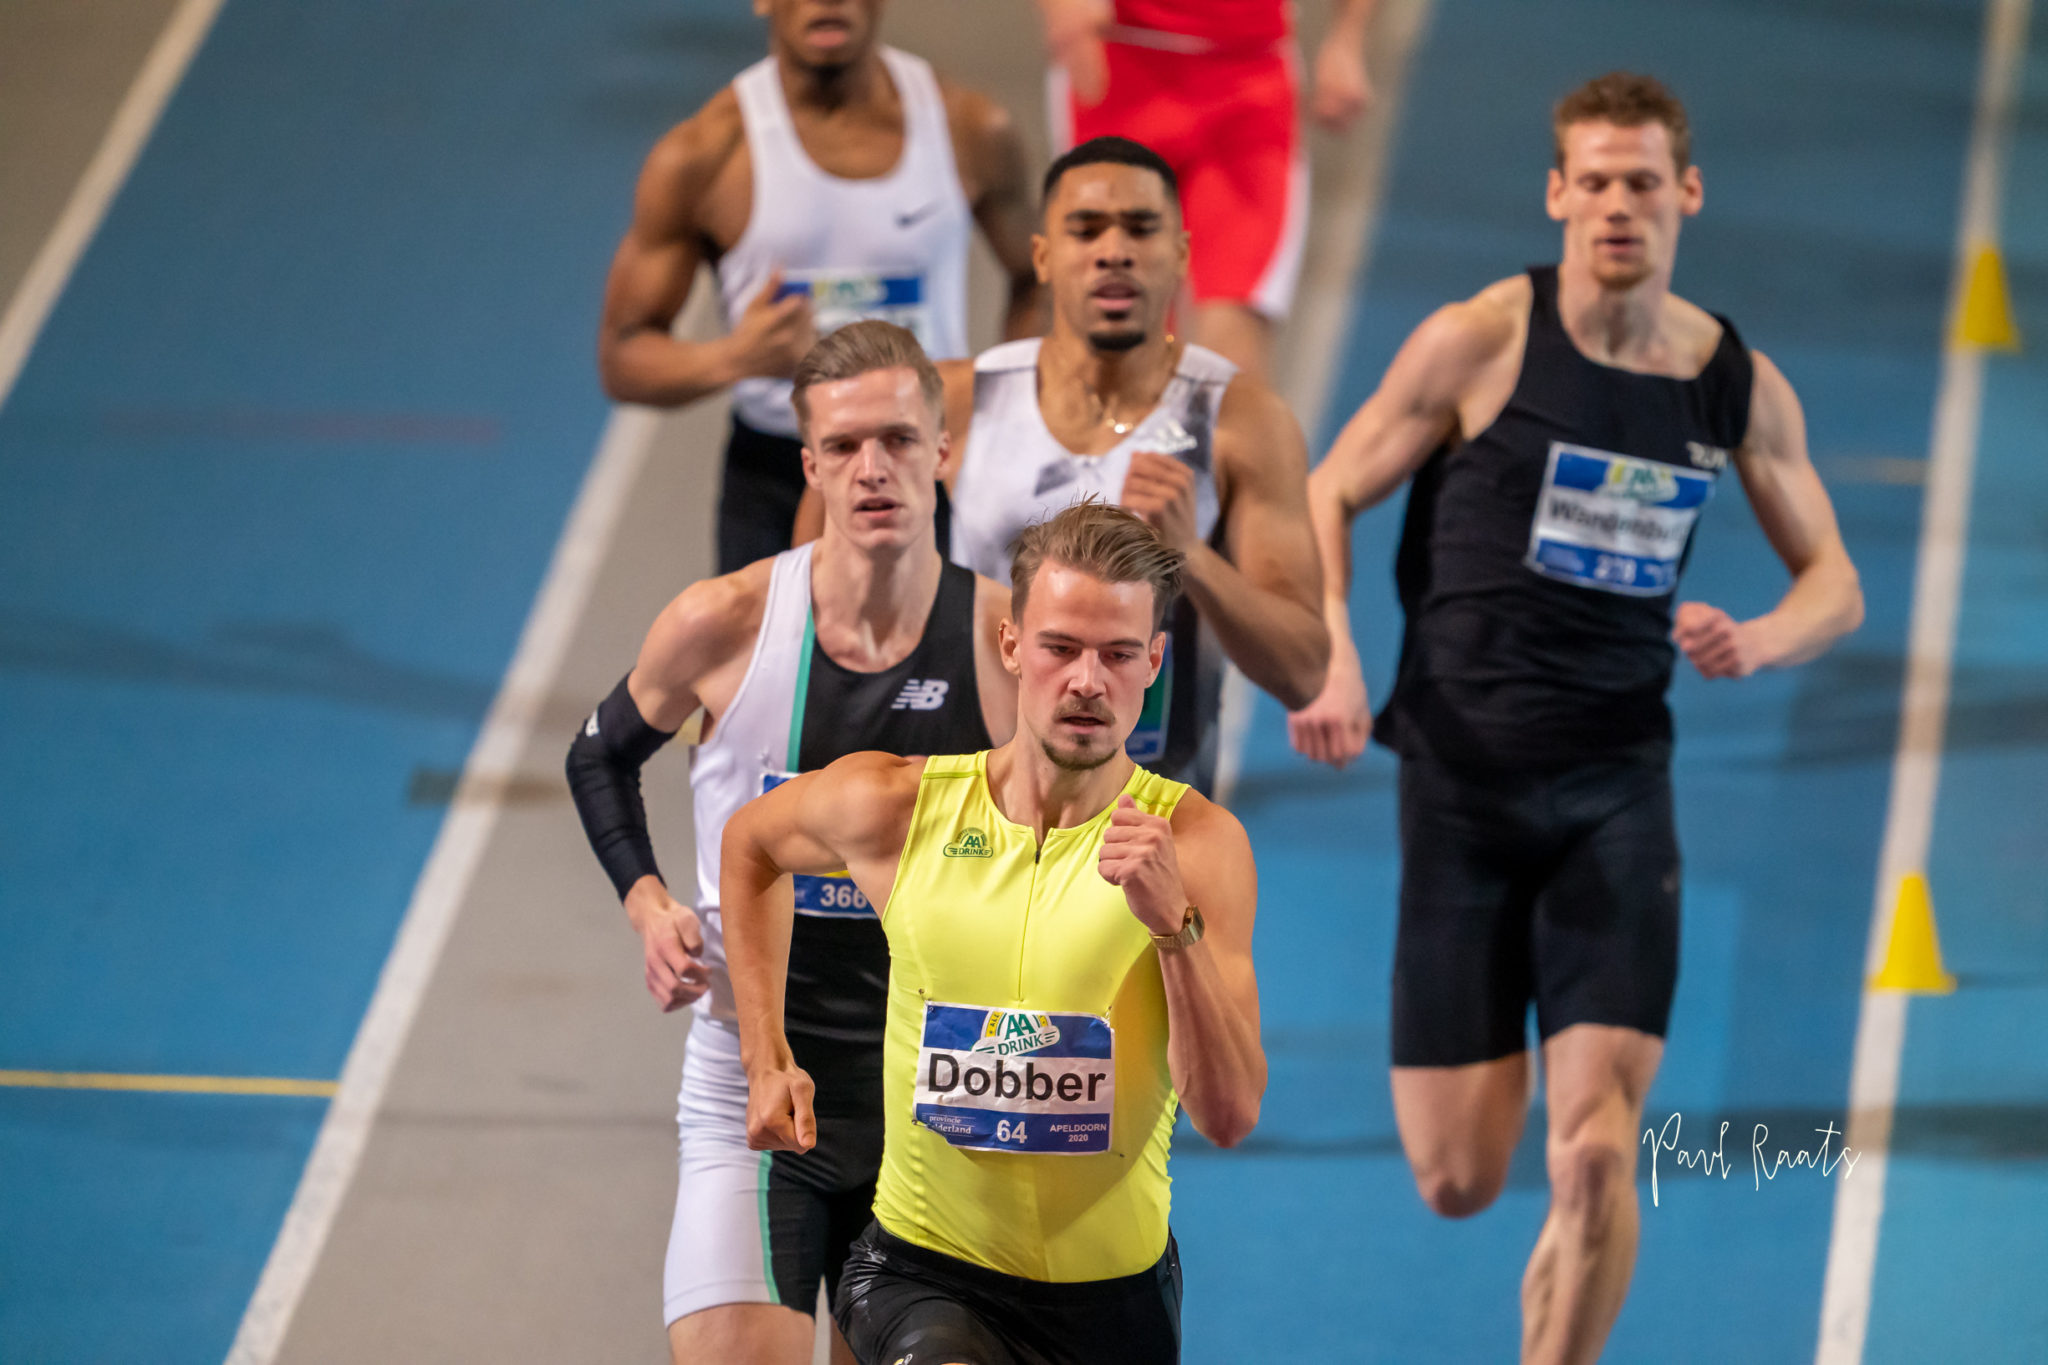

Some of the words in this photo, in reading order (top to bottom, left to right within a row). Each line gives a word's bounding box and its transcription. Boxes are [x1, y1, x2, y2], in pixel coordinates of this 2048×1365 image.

[963, 835, 981, 848] AA
[958, 847, 984, 856] DRINK
[820, 883, 868, 909] 366
[1004, 1013, 1036, 1041] AA
[998, 1033, 1044, 1056] DRINK
[928, 1053, 1106, 1102] Dobber
[929, 1115, 961, 1124] provincie
[1050, 1123, 1107, 1133] APELDOORN
[996, 1119, 1028, 1144] 64
[1068, 1134, 1089, 1143] 2020
